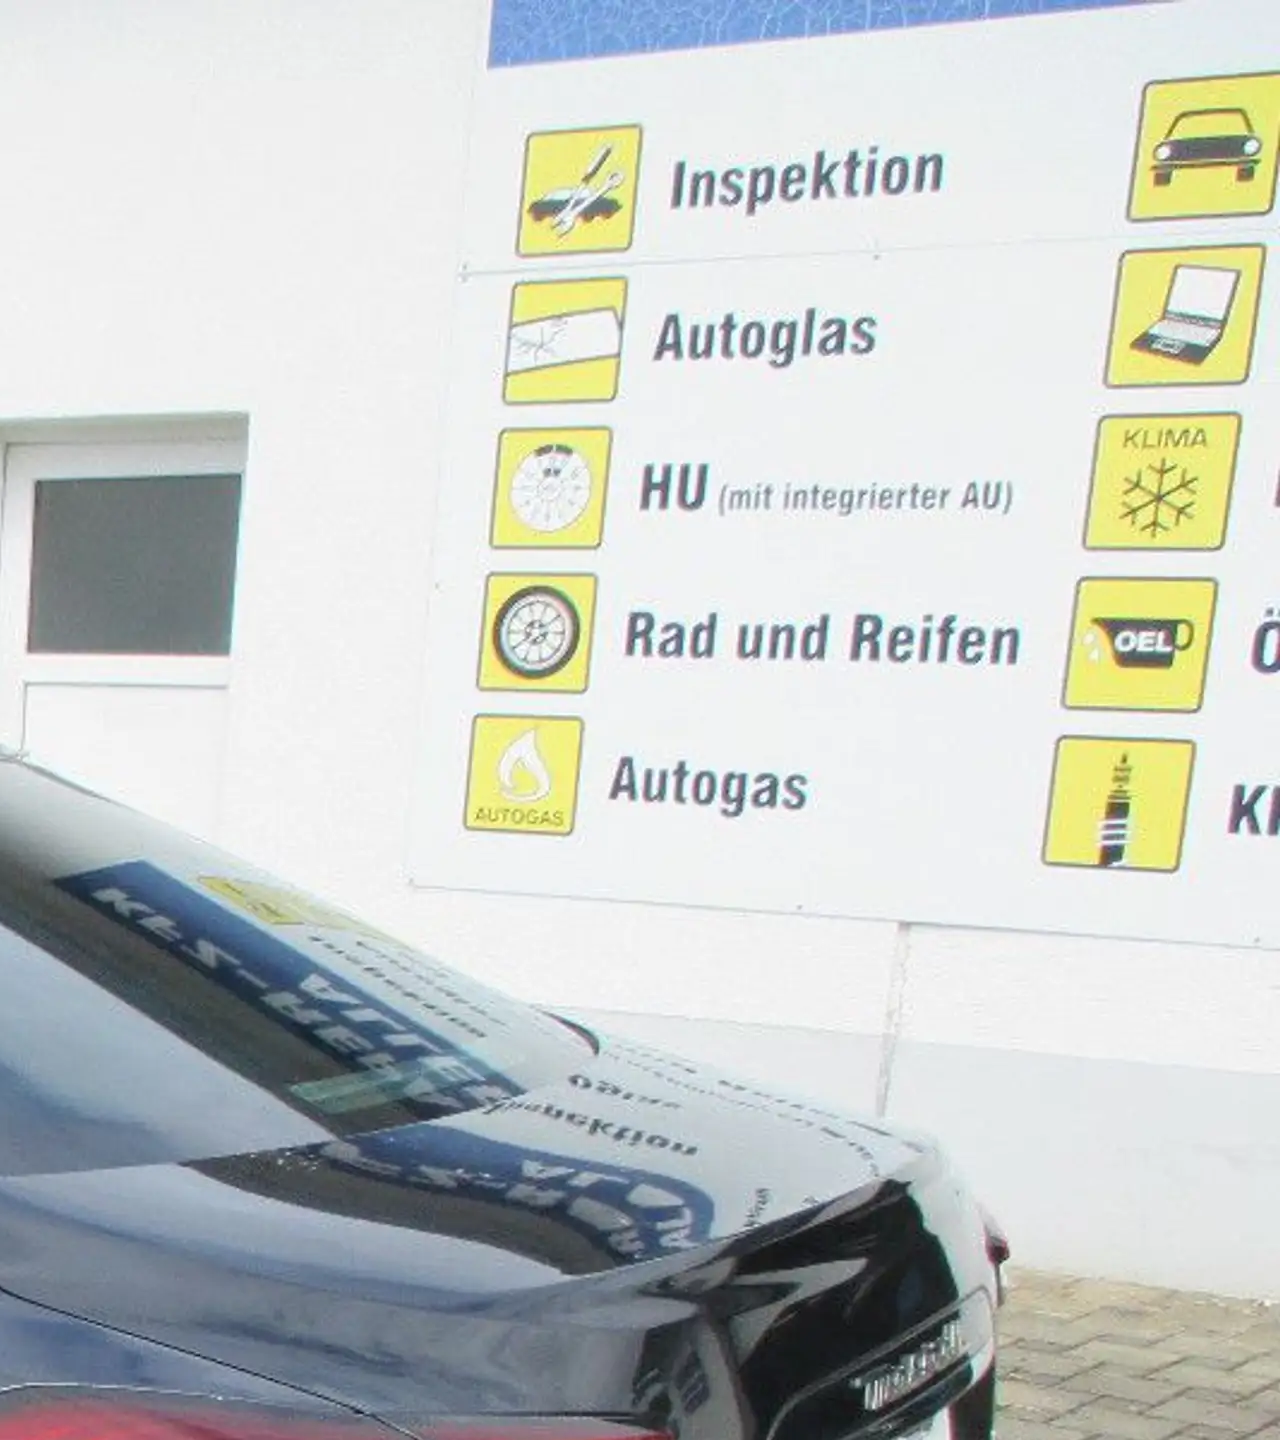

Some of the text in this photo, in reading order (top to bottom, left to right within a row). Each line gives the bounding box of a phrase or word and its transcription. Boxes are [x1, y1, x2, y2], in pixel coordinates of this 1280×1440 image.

[670, 146, 946, 216] Inspektion
[653, 308, 878, 368] Autoglas
[1122, 427, 1208, 448] KLIMA
[640, 463, 1014, 517] HU (mit integrierter AU)
[624, 611, 1022, 666] Rad und Reifen
[1114, 630, 1173, 652] OEL
[608, 756, 808, 817] Autogas
[474, 807, 565, 827] AUTOGAS
